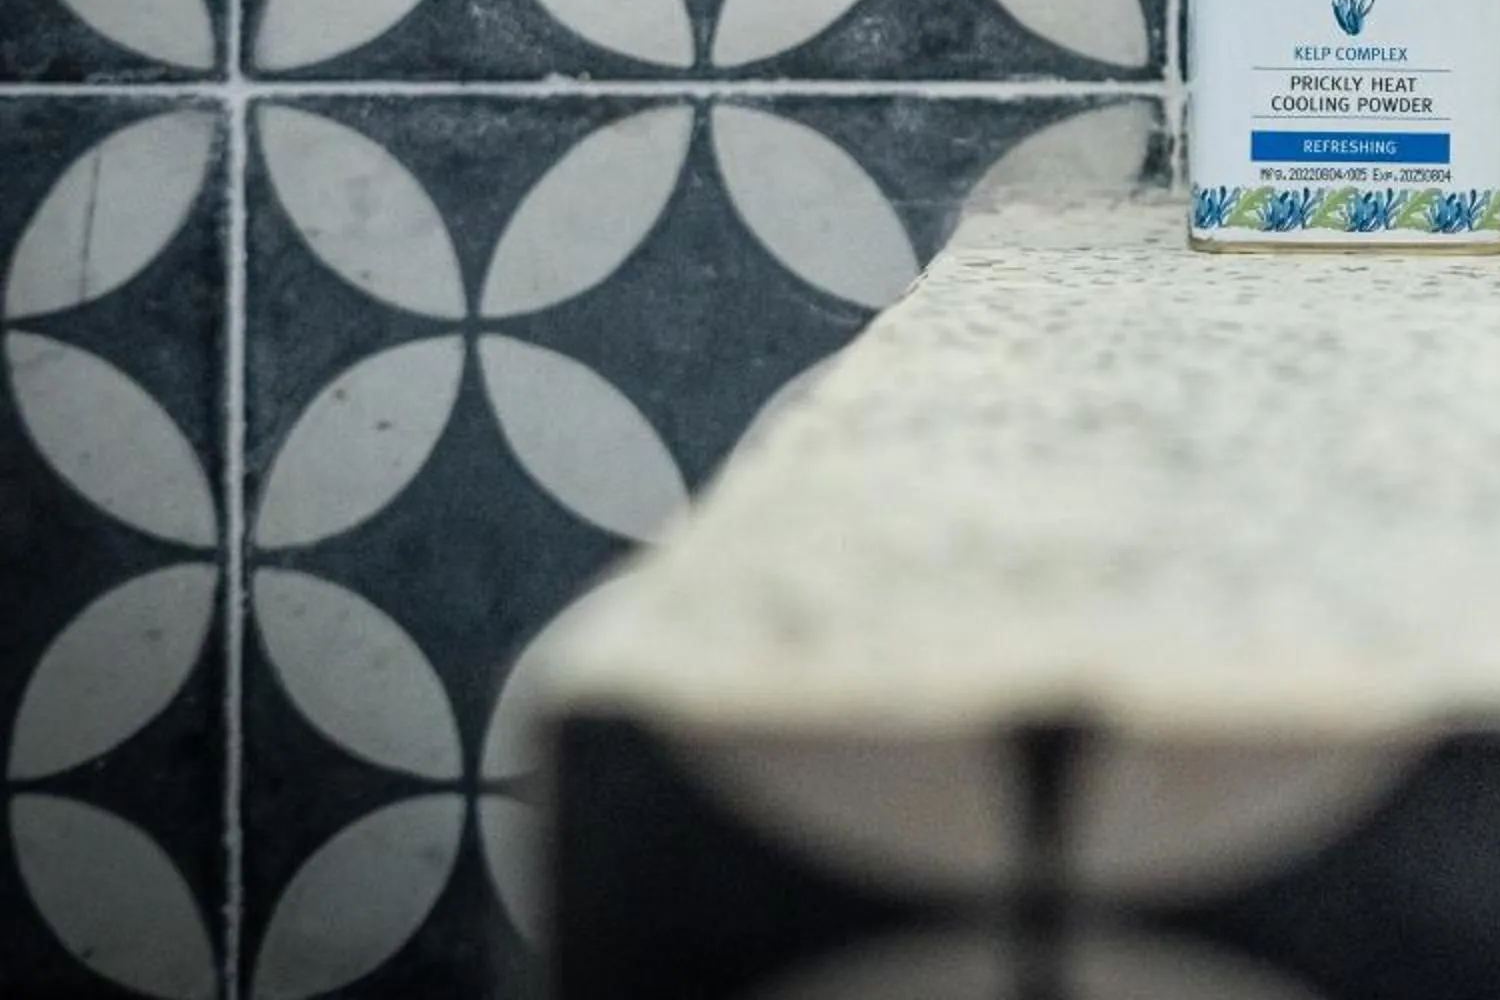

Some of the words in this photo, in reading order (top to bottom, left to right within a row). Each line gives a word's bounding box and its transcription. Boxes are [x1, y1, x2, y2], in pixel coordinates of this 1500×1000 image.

[1294, 47, 1331, 60] KELP
[1335, 48, 1408, 61] COMPLEX
[1290, 75, 1363, 92] PRICKLY
[1371, 77, 1418, 92] HEAT
[1271, 97, 1350, 112] COOLING
[1357, 97, 1433, 113] POWDER
[1303, 139, 1398, 154] REFRESHING
